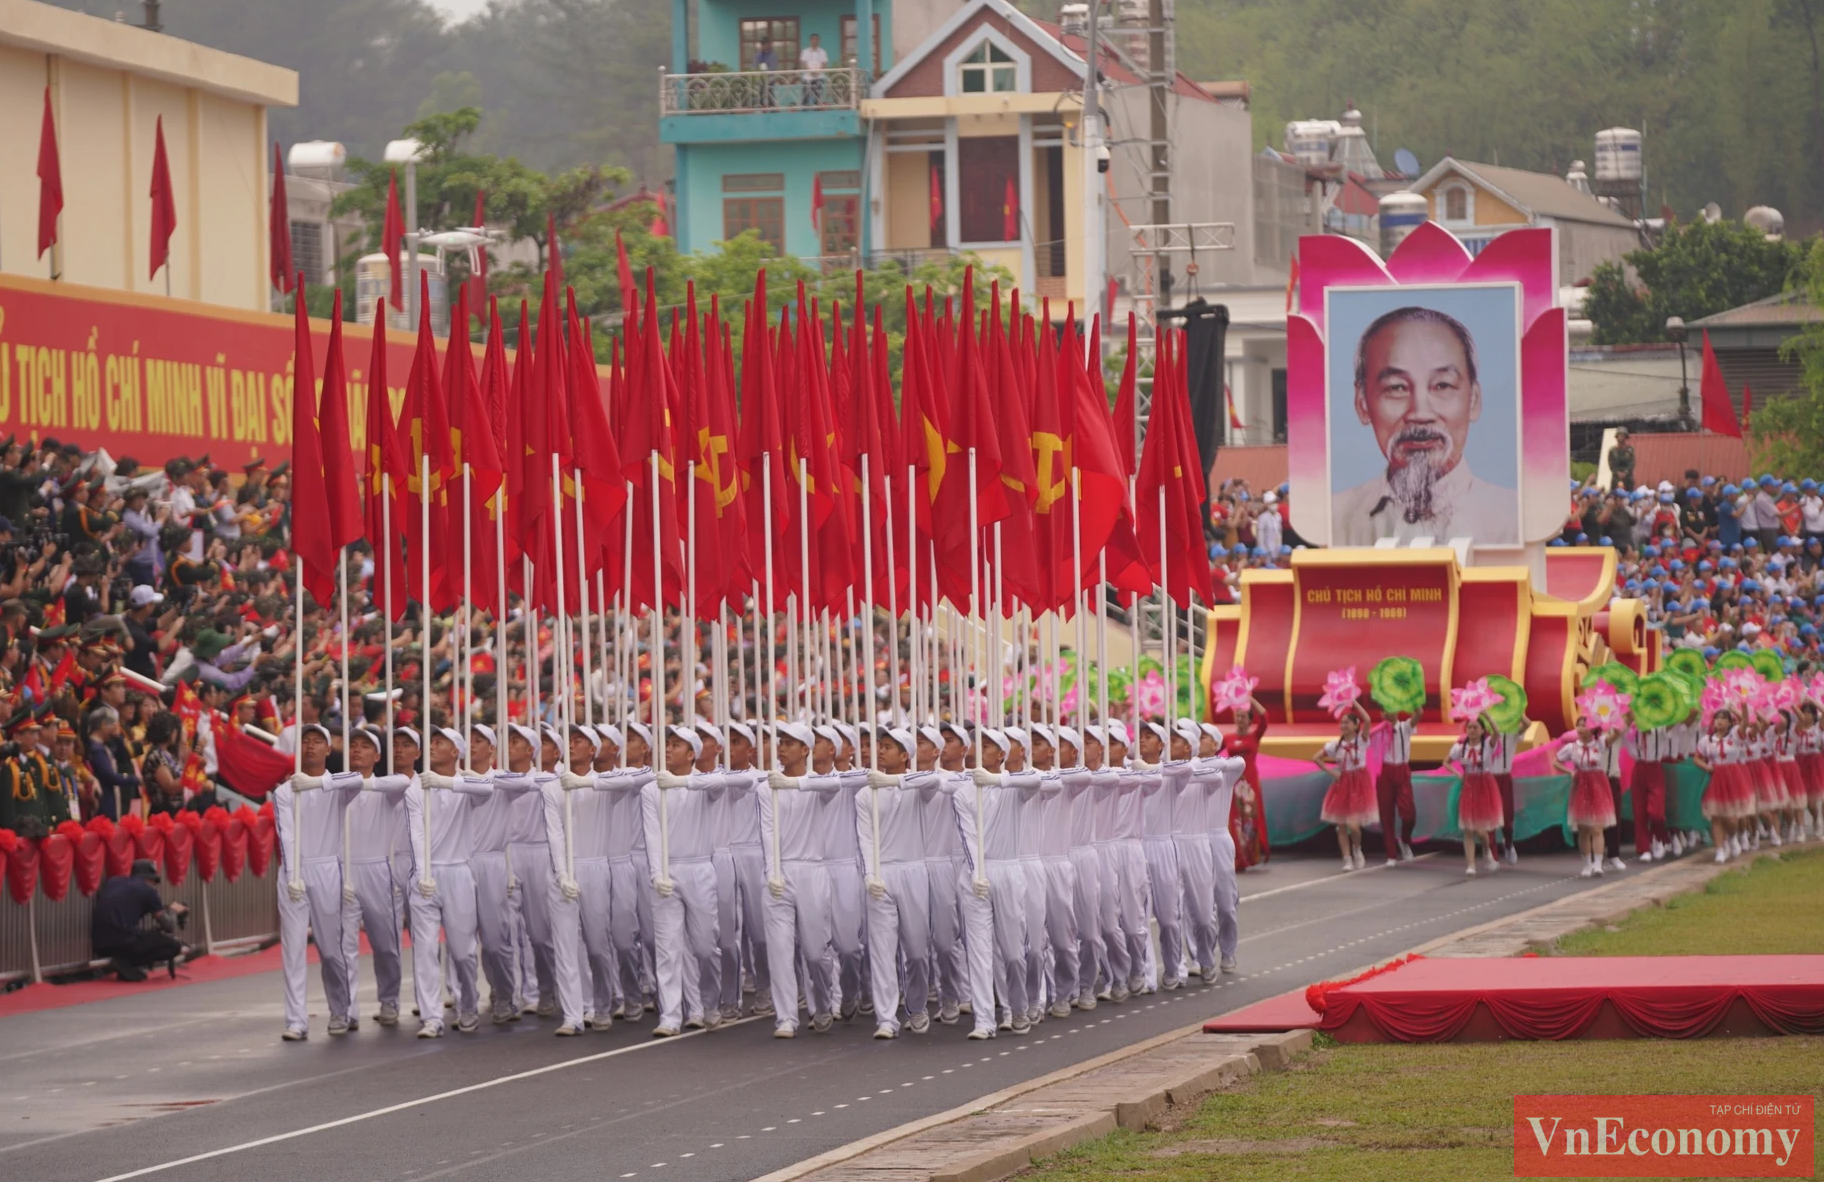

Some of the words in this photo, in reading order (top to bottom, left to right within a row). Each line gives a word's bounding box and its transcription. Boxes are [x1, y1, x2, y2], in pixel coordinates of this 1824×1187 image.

[16, 343, 67, 444] TỊCH
[71, 325, 101, 431] HỒ
[105, 340, 142, 433] CHÍ
[145, 358, 204, 438] MINH
[205, 352, 228, 440] VĨ
[230, 368, 268, 459] ĐẠI
[1307, 585, 1332, 602] CHỦ
[1335, 588, 1362, 604] TỊCH
[1410, 588, 1442, 601] MINH
